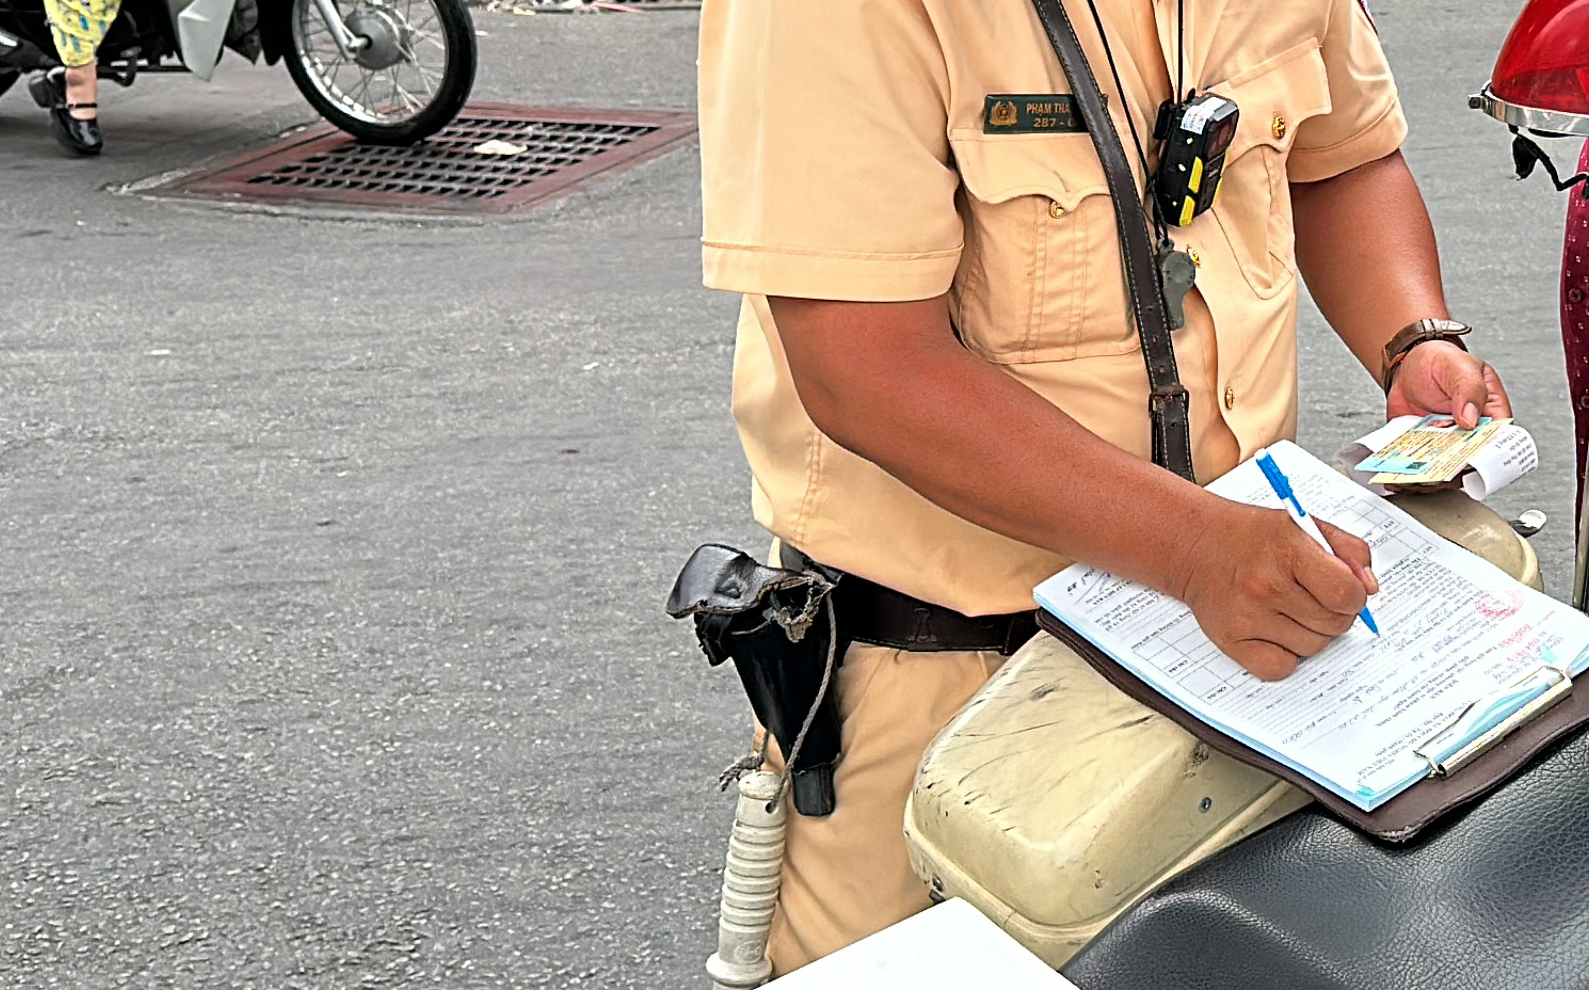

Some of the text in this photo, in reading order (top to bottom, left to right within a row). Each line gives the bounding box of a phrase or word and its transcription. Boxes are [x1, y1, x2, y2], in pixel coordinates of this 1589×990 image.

[1026, 103, 1071, 116] PHẠM THA
[1033, 117, 1056, 128] 287
